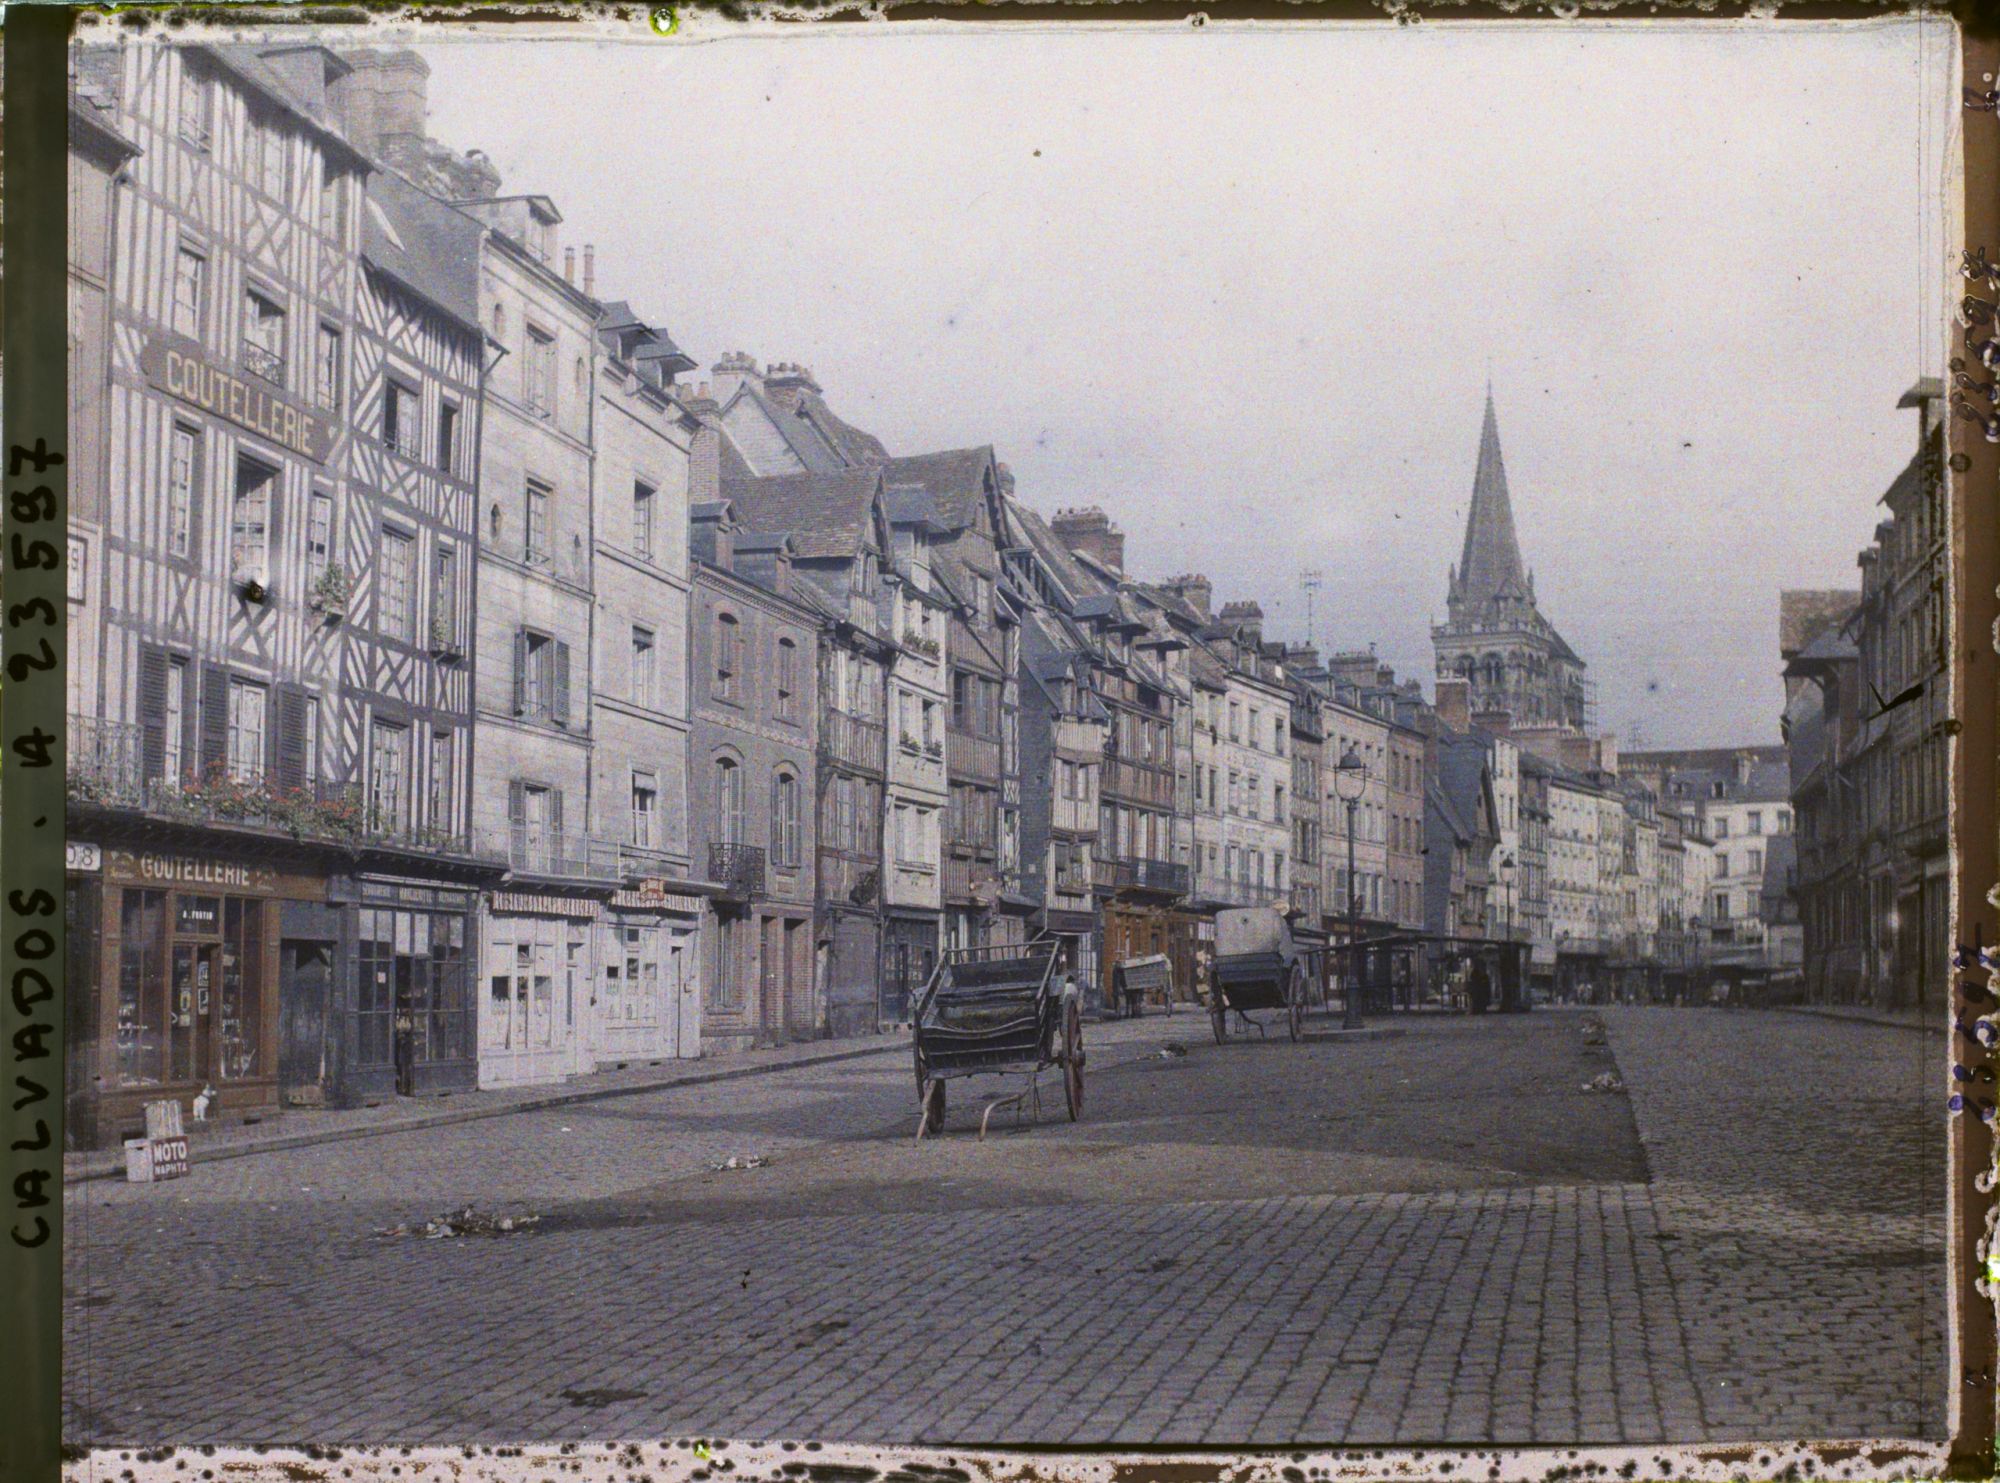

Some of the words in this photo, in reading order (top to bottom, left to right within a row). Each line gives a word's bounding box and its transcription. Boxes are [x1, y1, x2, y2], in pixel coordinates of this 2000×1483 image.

[167, 350, 314, 454] COUTELLERIE
[12, 726, 56, 768] A
[8, 888, 57, 1249] CALVADOS
[154, 1141, 187, 1162] MOTO
[154, 1161, 188, 1175] NAPHTA
